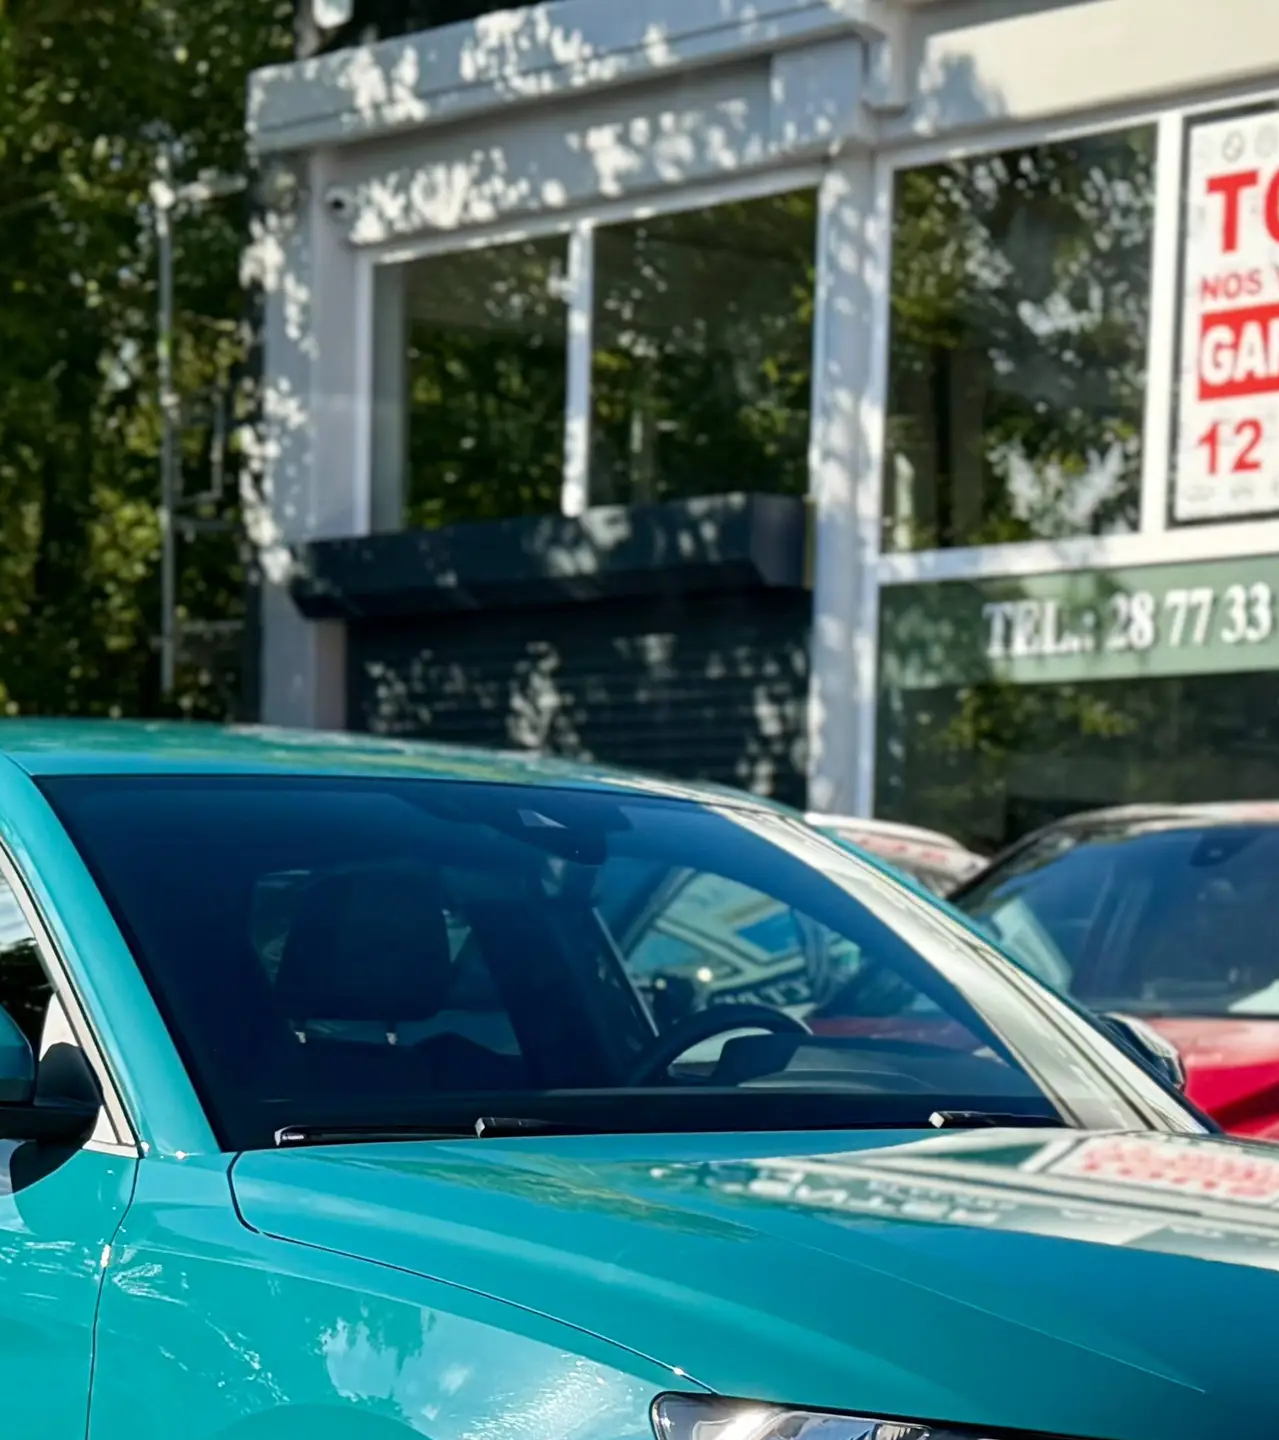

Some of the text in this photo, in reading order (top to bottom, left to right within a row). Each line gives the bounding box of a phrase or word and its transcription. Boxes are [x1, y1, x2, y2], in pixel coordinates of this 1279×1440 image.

[1200, 268, 1262, 302] NOS
[1198, 418, 1262, 476] 12
[1104, 590, 1155, 652] 28
[1165, 587, 1214, 646] 77
[1221, 581, 1272, 644] 33
